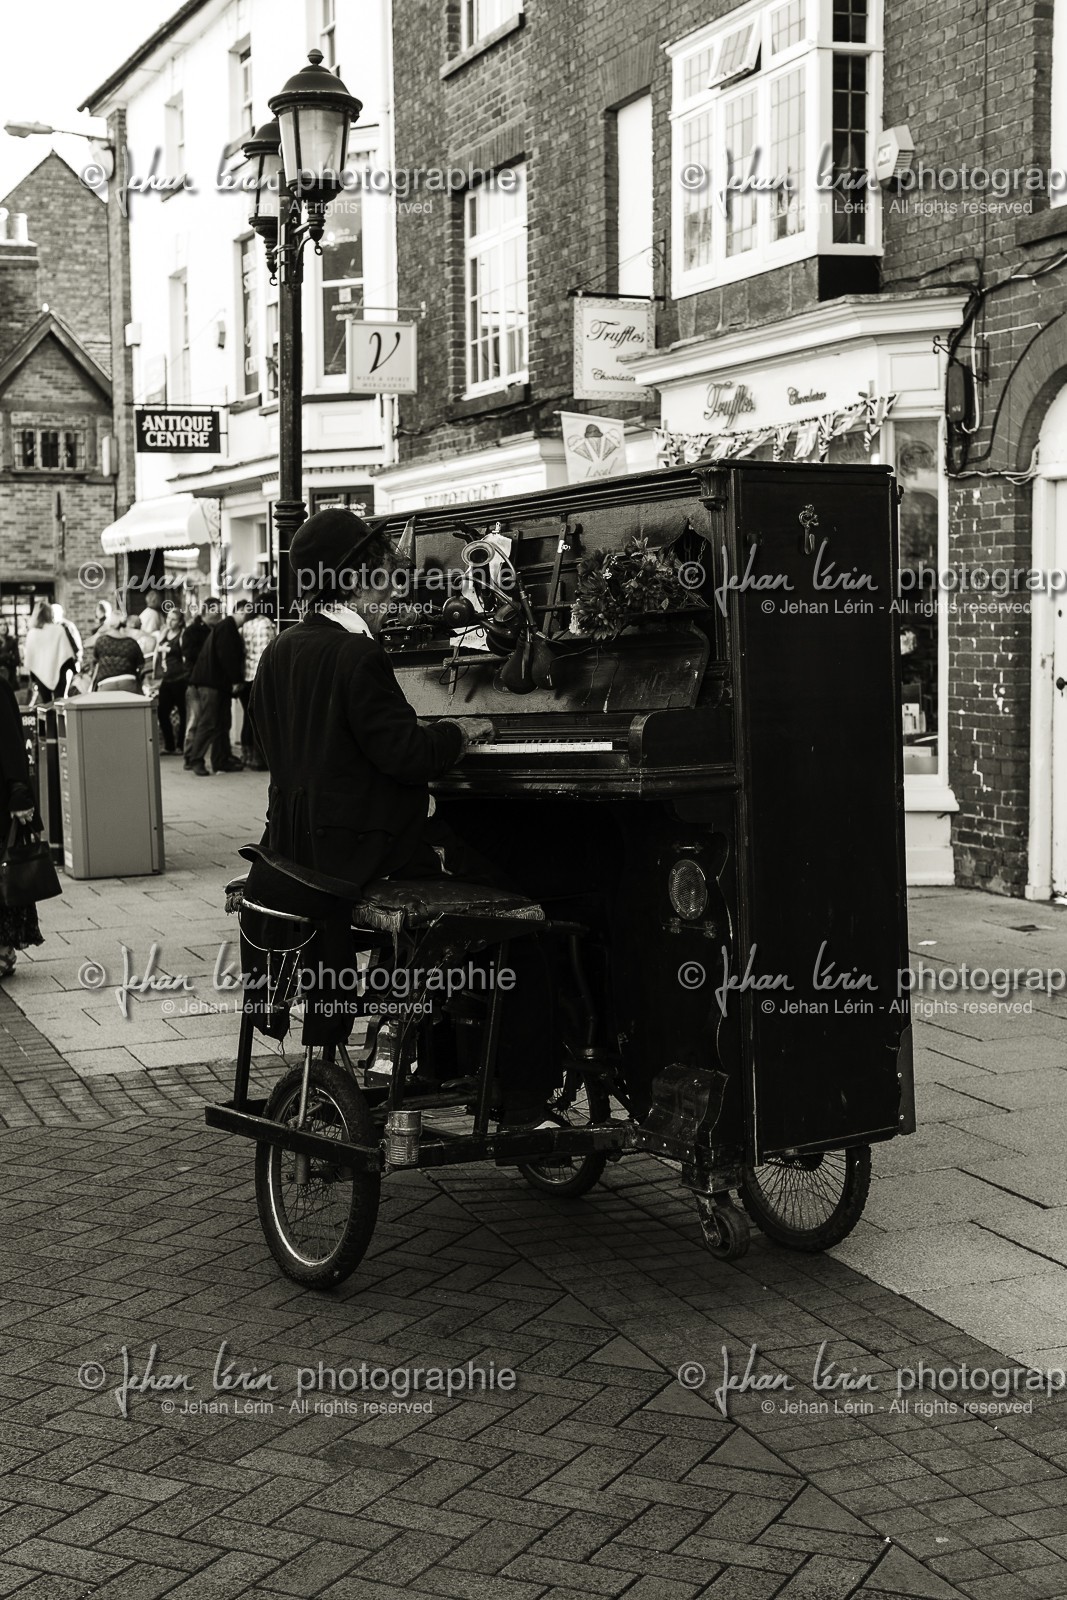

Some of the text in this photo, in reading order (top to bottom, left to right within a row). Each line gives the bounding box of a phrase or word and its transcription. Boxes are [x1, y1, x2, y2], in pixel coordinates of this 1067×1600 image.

[586, 319, 645, 349] Truffles
[142, 414, 213, 432] ANTIQUE
[145, 430, 210, 448] CENTRE
